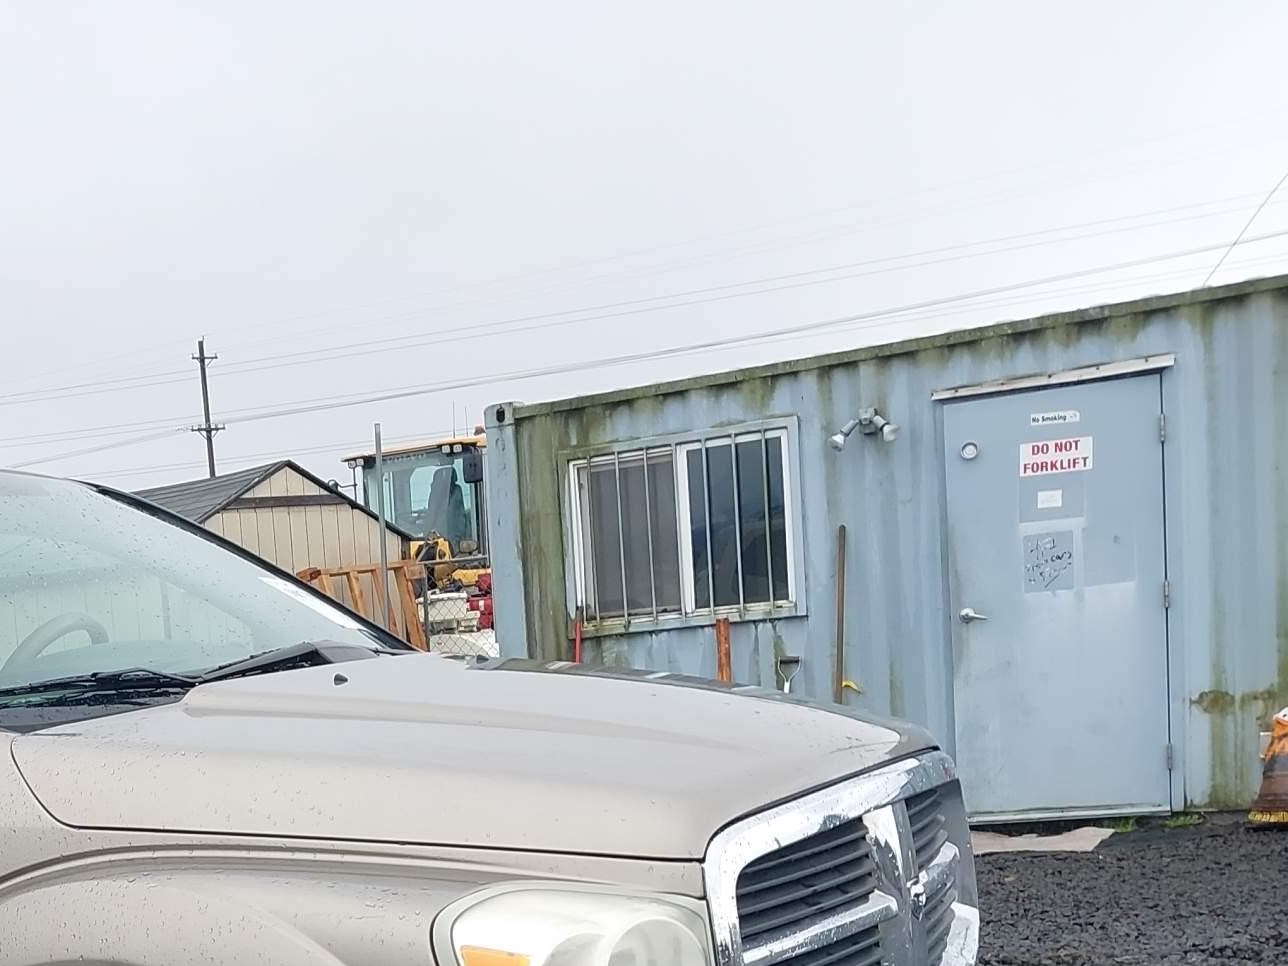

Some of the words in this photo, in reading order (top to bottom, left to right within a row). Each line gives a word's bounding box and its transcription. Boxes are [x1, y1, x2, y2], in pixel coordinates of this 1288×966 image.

[1031, 416, 1040, 424] No
[1041, 413, 1067, 423] Smoking
[1031, 443, 1049, 456] DO
[1054, 440, 1081, 453] NOT
[1023, 456, 1089, 474] FORKLIFT
